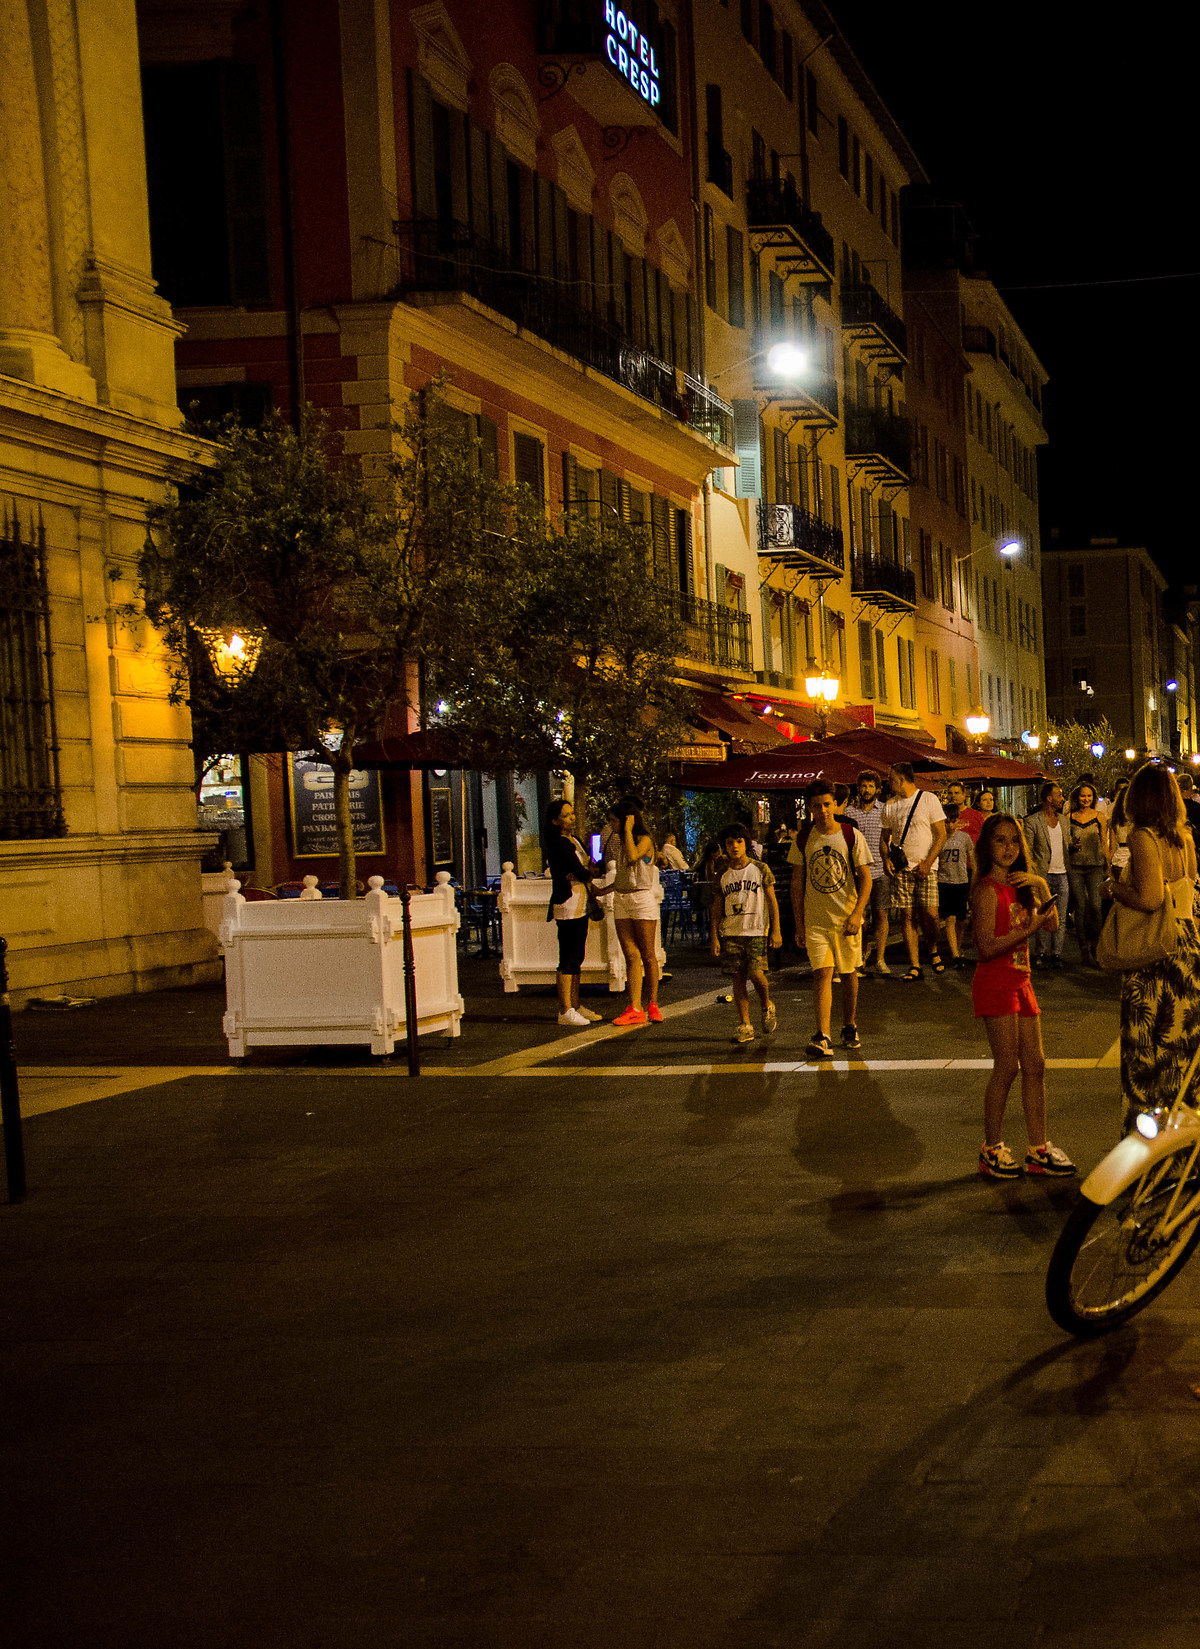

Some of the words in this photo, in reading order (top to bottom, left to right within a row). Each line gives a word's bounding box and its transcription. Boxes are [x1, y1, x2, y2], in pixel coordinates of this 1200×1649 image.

[605, 0, 660, 79] HOTEL
[605, 33, 660, 107] CRESP
[745, 769, 825, 781] Jeannot
[944, 848, 960, 863] 79
